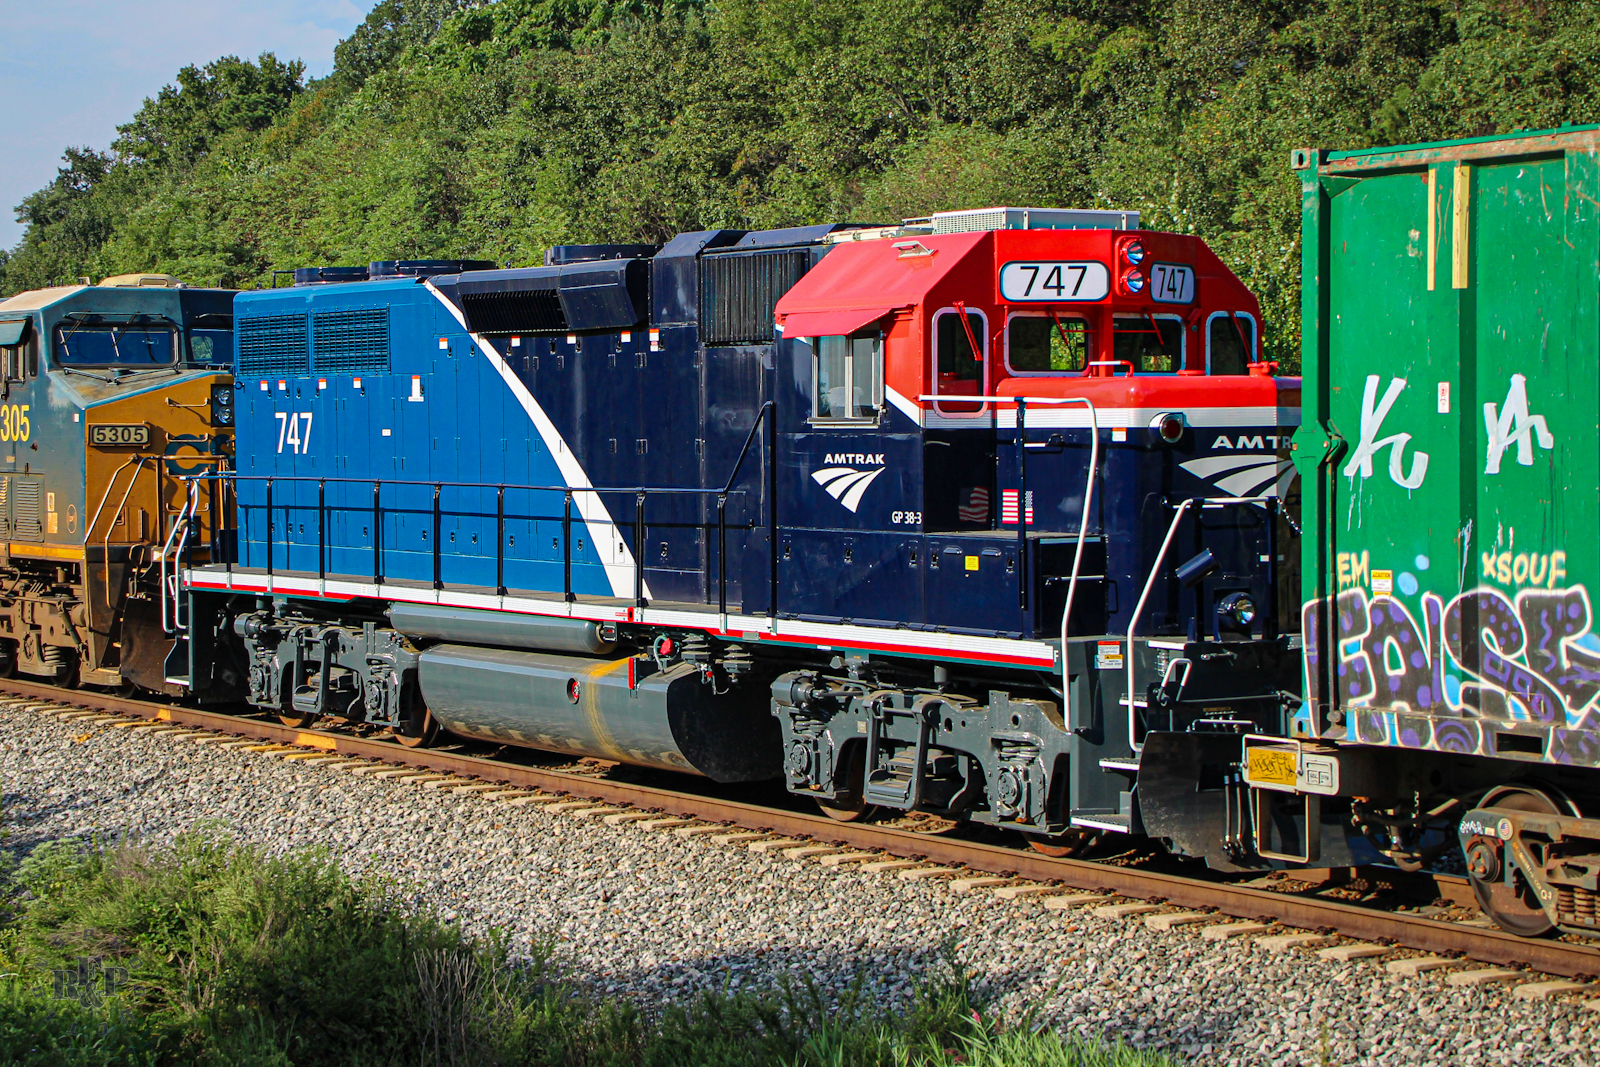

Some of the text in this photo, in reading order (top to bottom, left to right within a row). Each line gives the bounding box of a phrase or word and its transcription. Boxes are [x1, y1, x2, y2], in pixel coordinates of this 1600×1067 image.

[1020, 265, 1088, 297] 747
[1158, 267, 1186, 300] 747
[96, 427, 144, 442] 5305
[274, 411, 314, 455] 747
[823, 453, 886, 465] AMTRAK
[891, 510, 923, 525] GP 38-3
[1053, 649, 1060, 663] F
